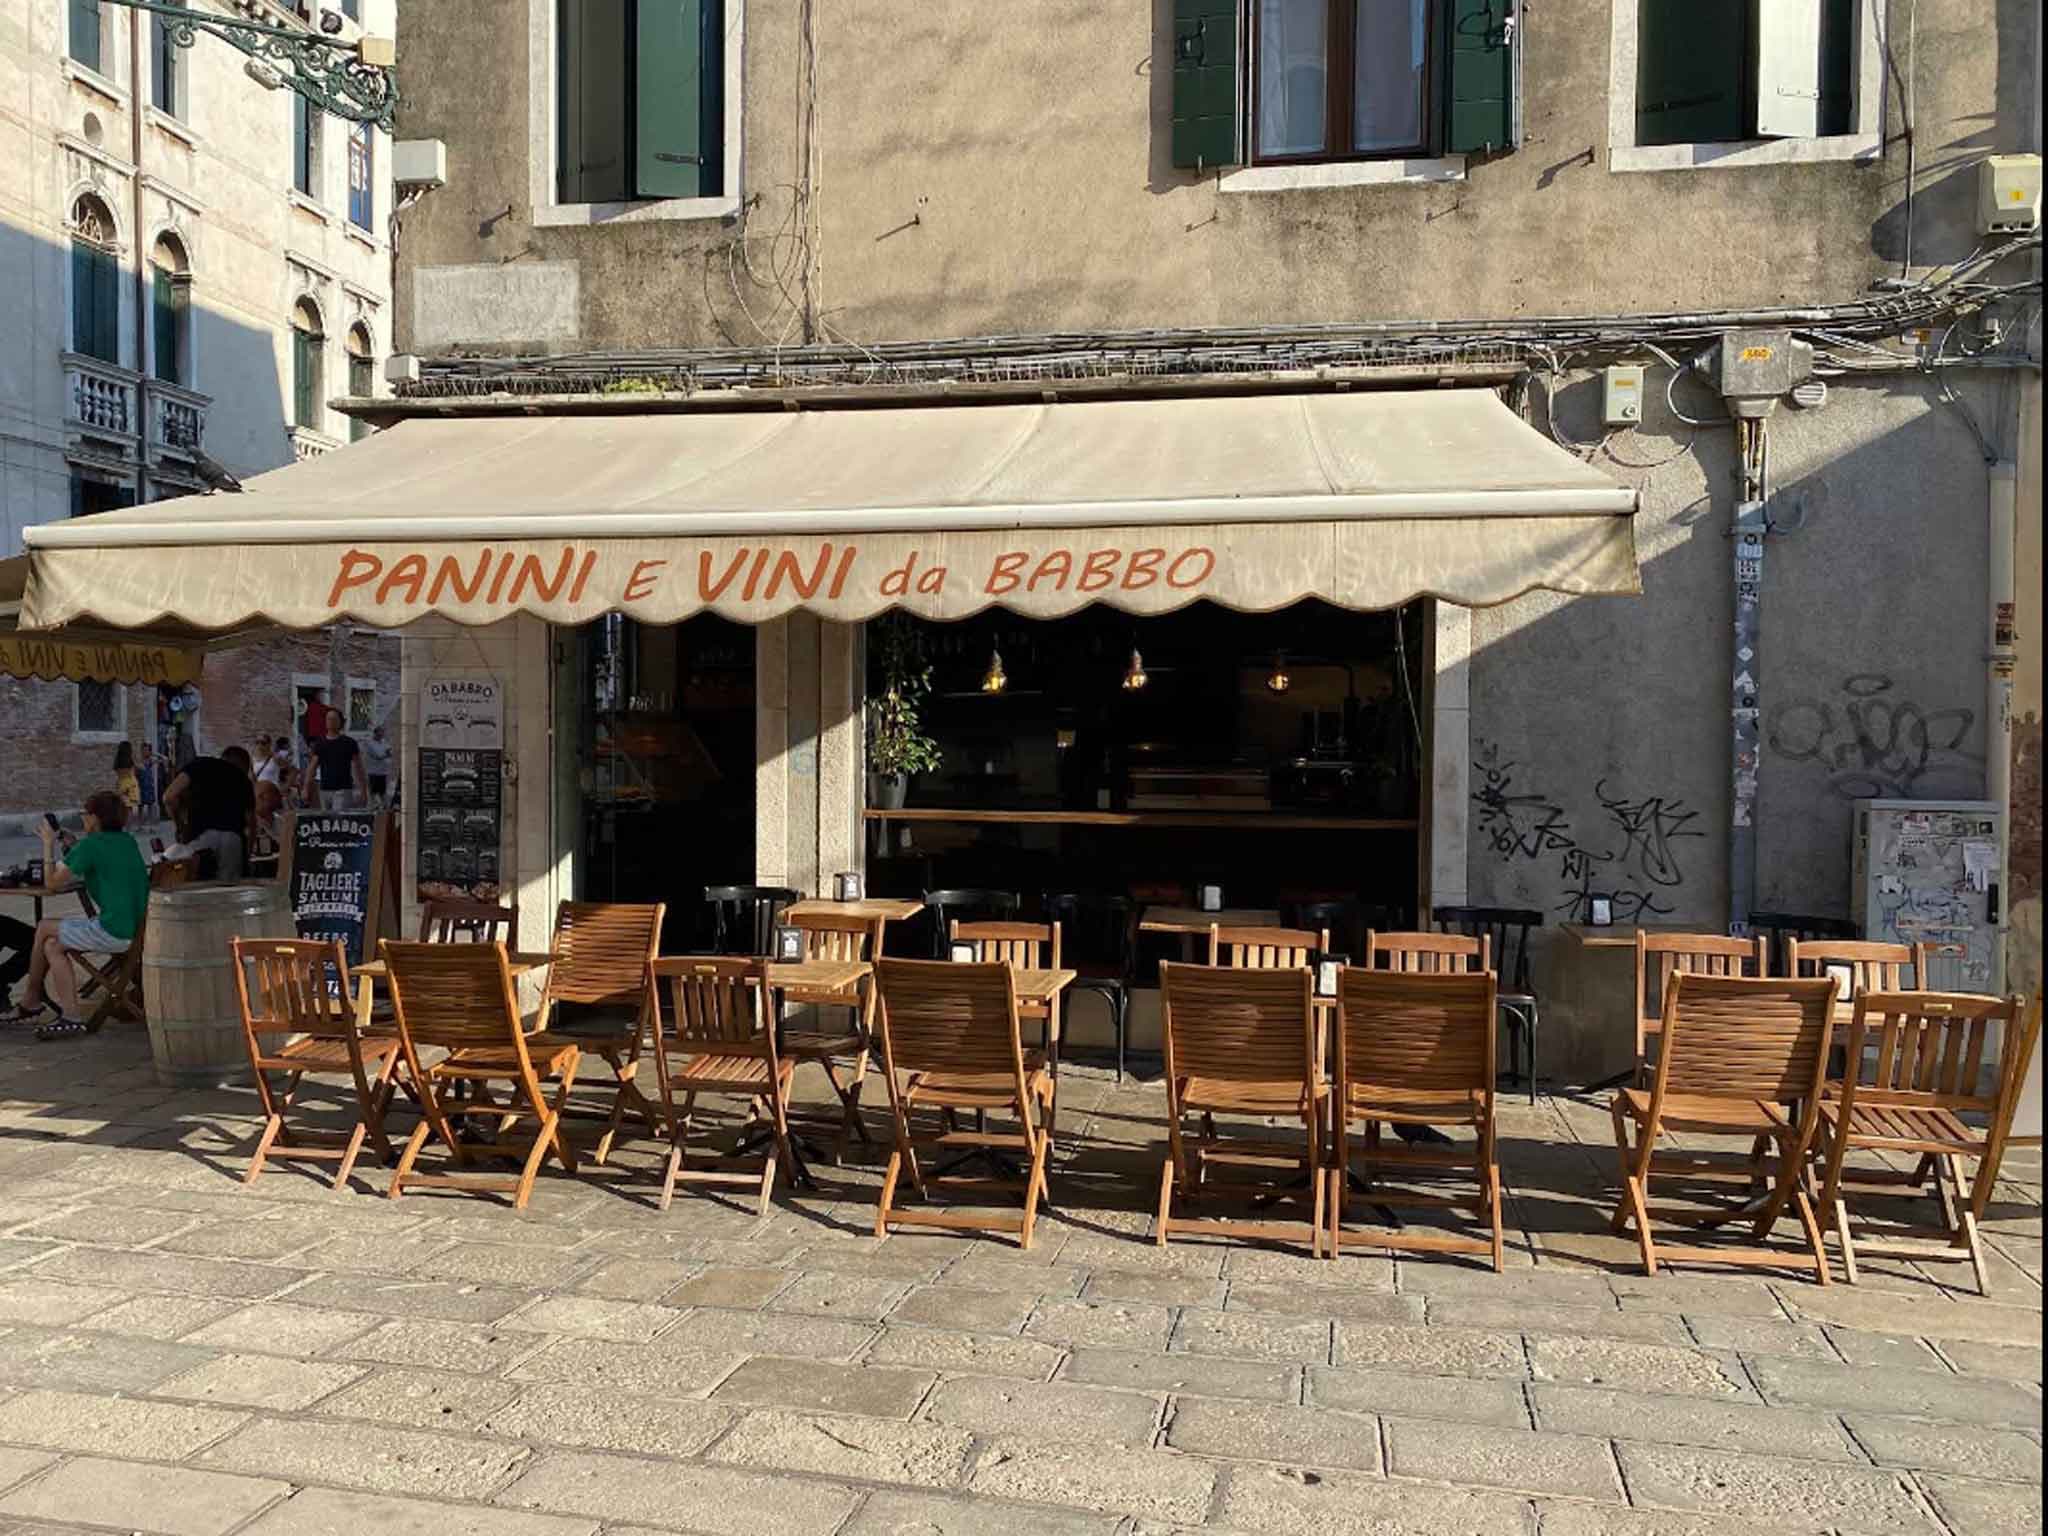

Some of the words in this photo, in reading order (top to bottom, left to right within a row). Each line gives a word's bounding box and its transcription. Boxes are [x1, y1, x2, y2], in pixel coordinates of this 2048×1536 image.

[329, 547, 597, 607] PANINI
[624, 560, 667, 600] E
[699, 543, 857, 601] VINI
[879, 551, 947, 595] da
[984, 546, 1216, 595] BABBO
[299, 871, 362, 892] TAGLIERE
[297, 891, 359, 904] SALUMI
